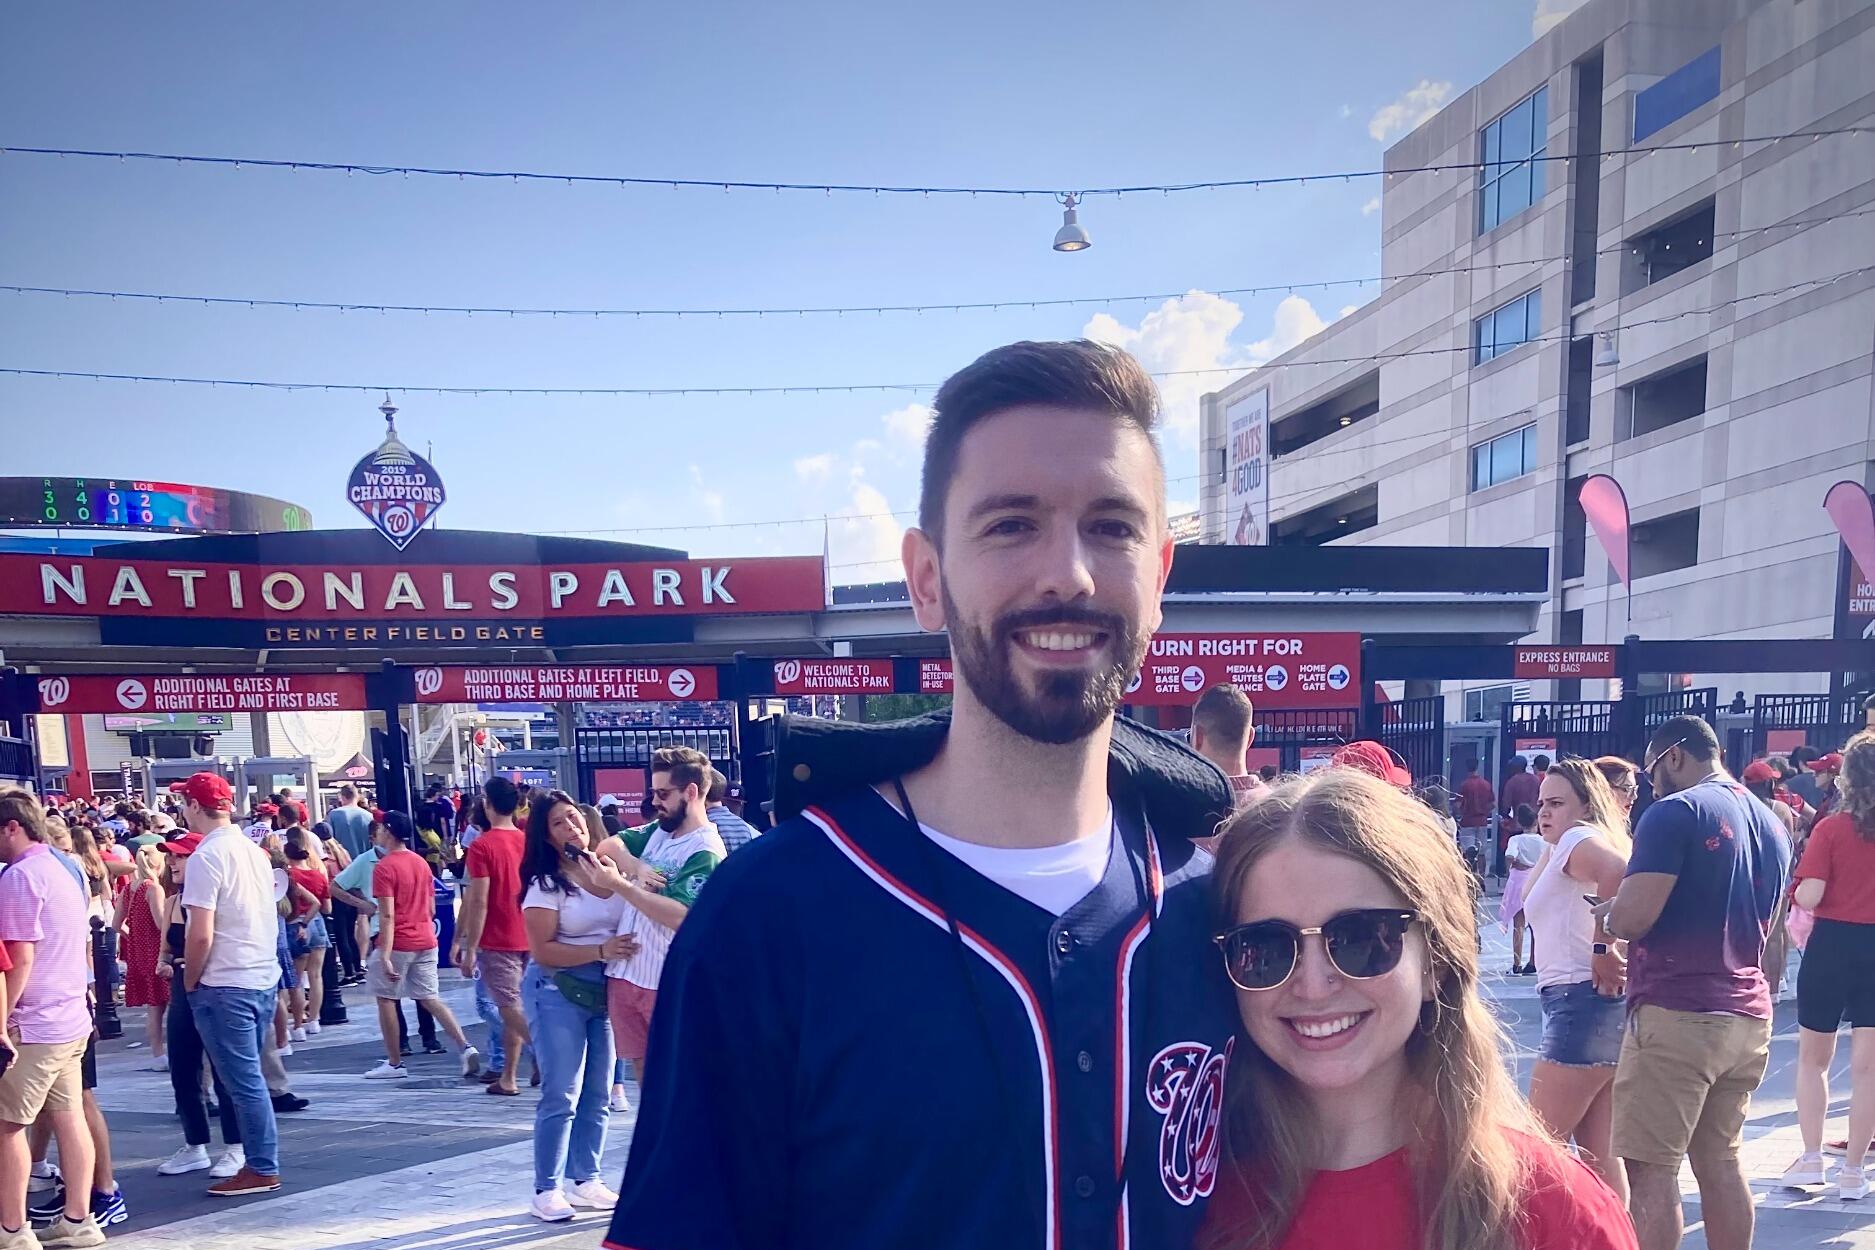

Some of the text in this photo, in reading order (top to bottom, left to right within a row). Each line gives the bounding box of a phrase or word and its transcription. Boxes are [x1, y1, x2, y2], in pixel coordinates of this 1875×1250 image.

[1232, 424, 1261, 464] #NATS
[381, 466, 407, 475] 2019
[364, 471, 427, 486] WORLD
[1232, 458, 1261, 496] 4GOOD
[76, 480, 84, 488] H
[109, 481, 116, 489] E
[133, 481, 153, 491] LOB
[44, 491, 150, 507] 3 4 0 2
[351, 485, 442, 502] CHAMPIONS
[45, 507, 153, 523] 0 0 1 0
[40, 563, 736, 611] NATIONALS PARK
[1857, 584, 1875, 597] HO
[266, 626, 545, 642] CENTER FIELD GATE
[1151, 639, 1303, 656] URN RIGHT FOR
[1519, 651, 1610, 663] EXPRESS ENTRANCE
[803, 664, 870, 676] WELCOME TO
[922, 663, 941, 671] METAL
[1152, 666, 1180, 674] THIRD
[1226, 665, 1264, 673] MEDIA &
[1548, 664, 1580, 673] NO BAGS
[464, 668, 663, 685] ADDITIONAL GATES AT LEFT FIELD,
[804, 676, 889, 688] NATIONALS PARK
[922, 672, 954, 680] DETECTOR
[1155, 675, 1180, 683] BASE
[1232, 674, 1264, 682] SUITES
[1298, 674, 1326, 682] PLATE
[154, 677, 291, 693] ADDITIONAL GATES AT
[922, 681, 944, 689] IN-USE
[1155, 684, 1180, 693] GATE
[1302, 683, 1326, 691] GATE
[464, 684, 639, 699] THIRD BASE AND HOME PLATE
[155, 692, 339, 709] RIGHT FIELD AND FIRST BASE
